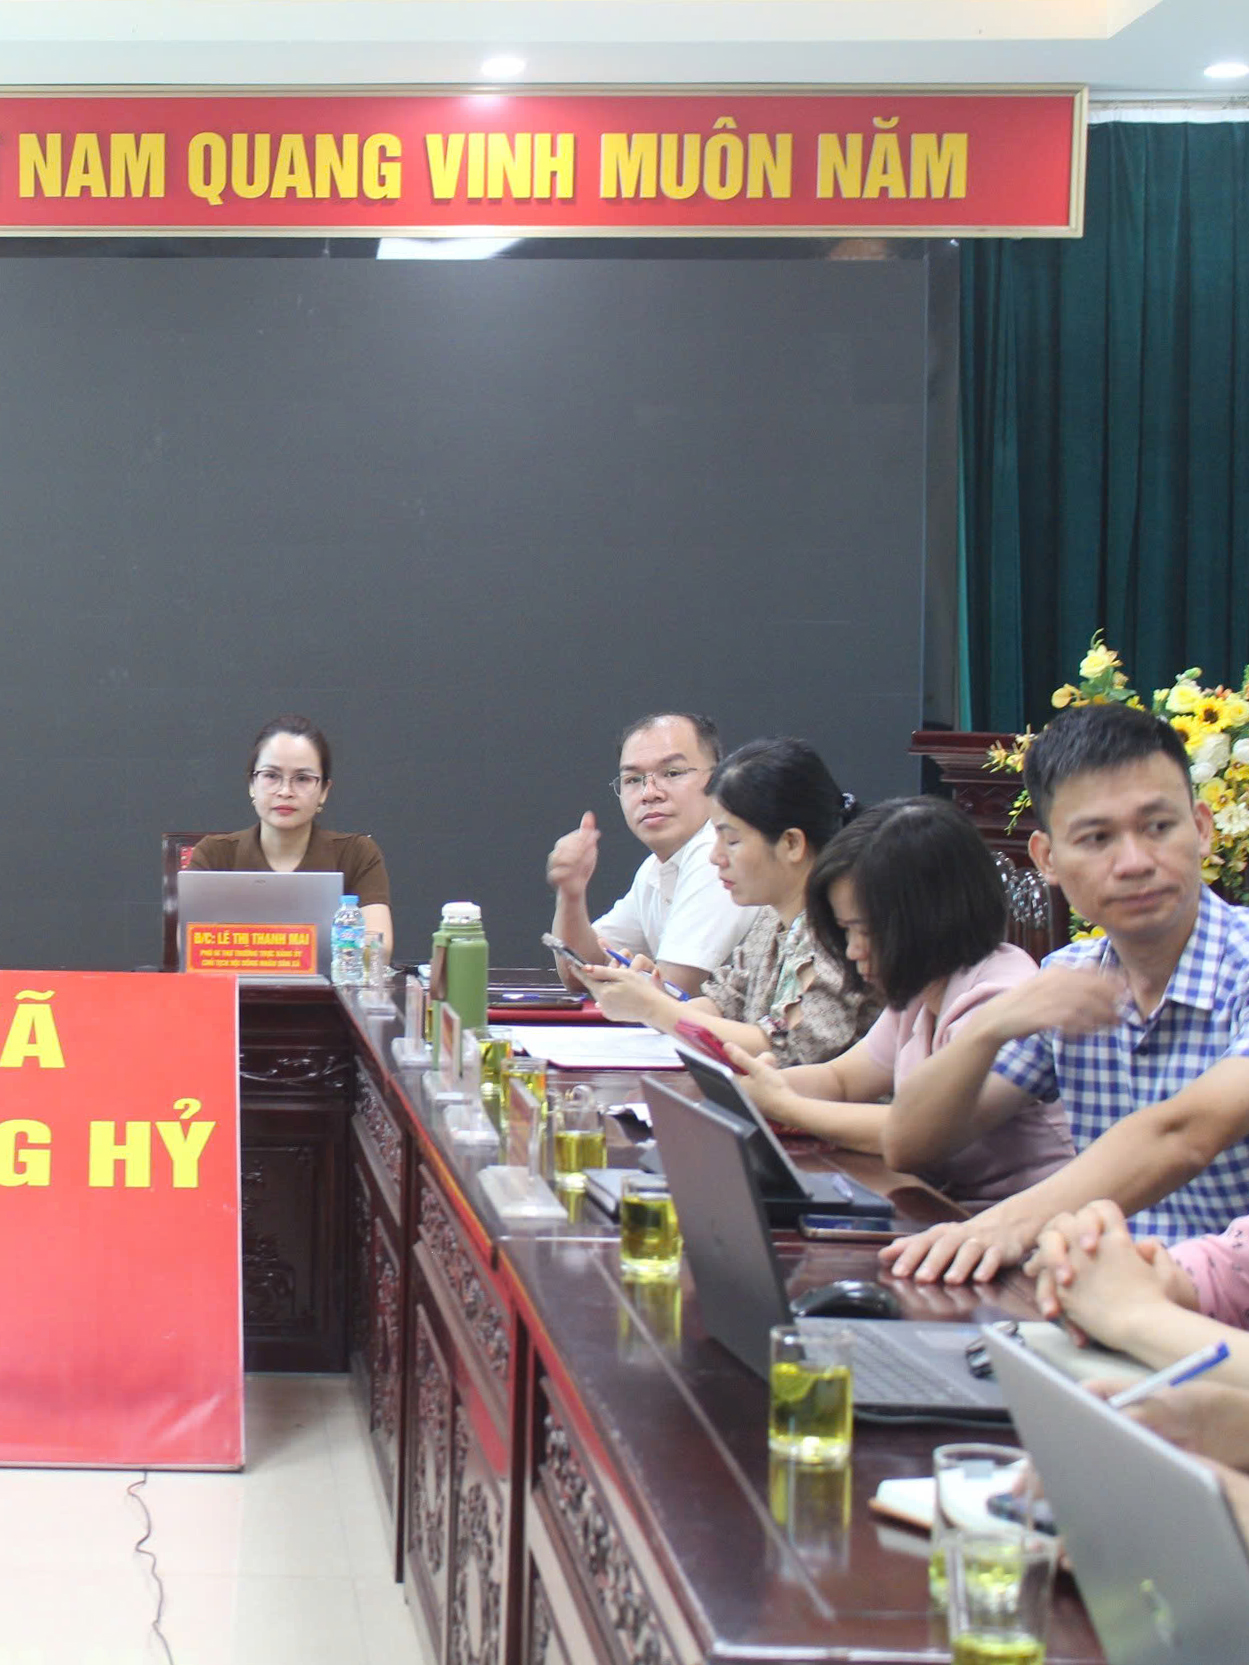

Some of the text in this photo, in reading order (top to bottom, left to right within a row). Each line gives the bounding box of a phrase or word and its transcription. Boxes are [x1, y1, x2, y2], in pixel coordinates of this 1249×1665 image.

[18, 133, 166, 198] NAM
[188, 132, 403, 206] QUANG
[425, 131, 575, 199] VINH
[599, 117, 792, 200] MUÔN
[818, 117, 968, 199] NĂM
[87, 1097, 217, 1190] HỶ
